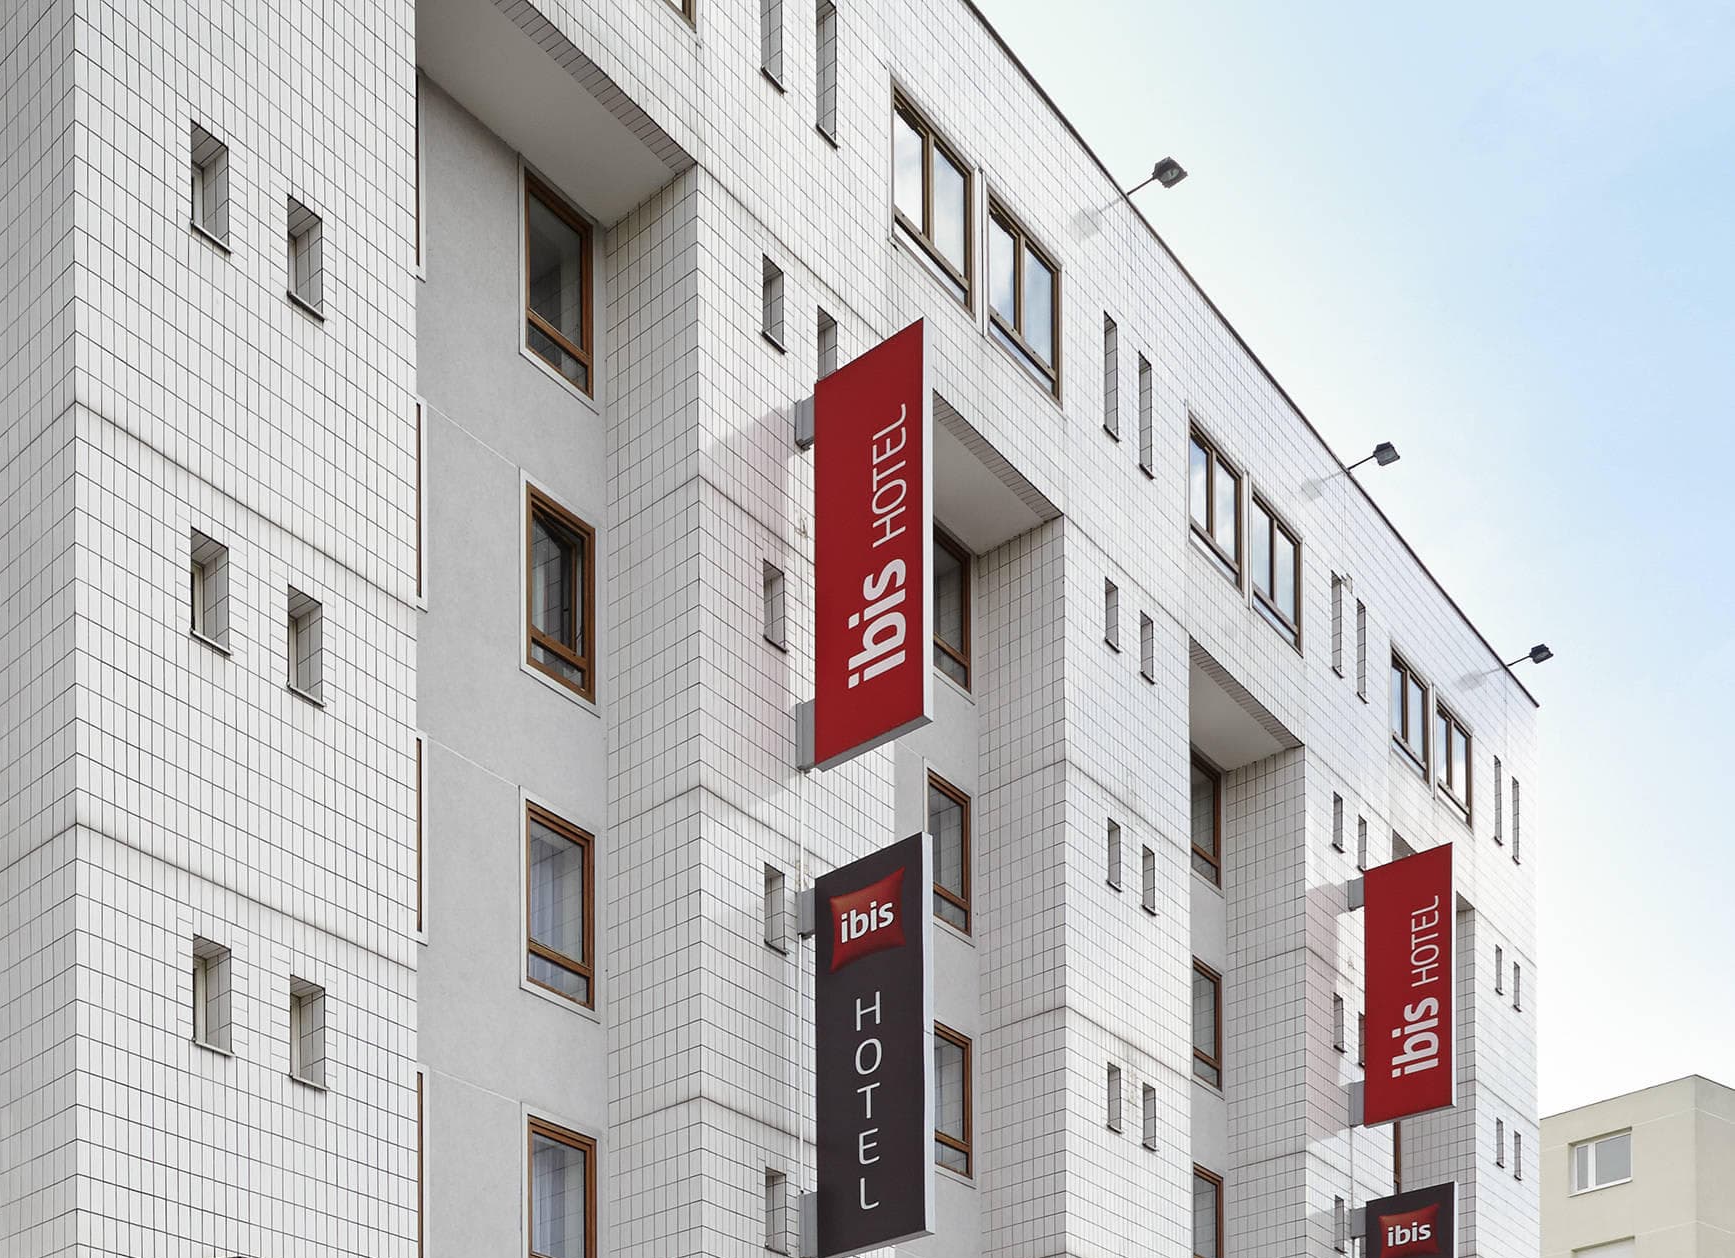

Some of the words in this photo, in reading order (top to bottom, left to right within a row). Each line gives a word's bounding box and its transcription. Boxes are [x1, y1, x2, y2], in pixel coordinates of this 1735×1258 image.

[872, 402, 907, 549] HOTEL
[848, 558, 907, 689] ibis
[840, 900, 895, 944] ibis
[1411, 895, 1440, 988] HOTEL
[1391, 996, 1440, 1079] ibis
[853, 990, 884, 1211] HOTEL
[1387, 1222, 1432, 1247] ibis
